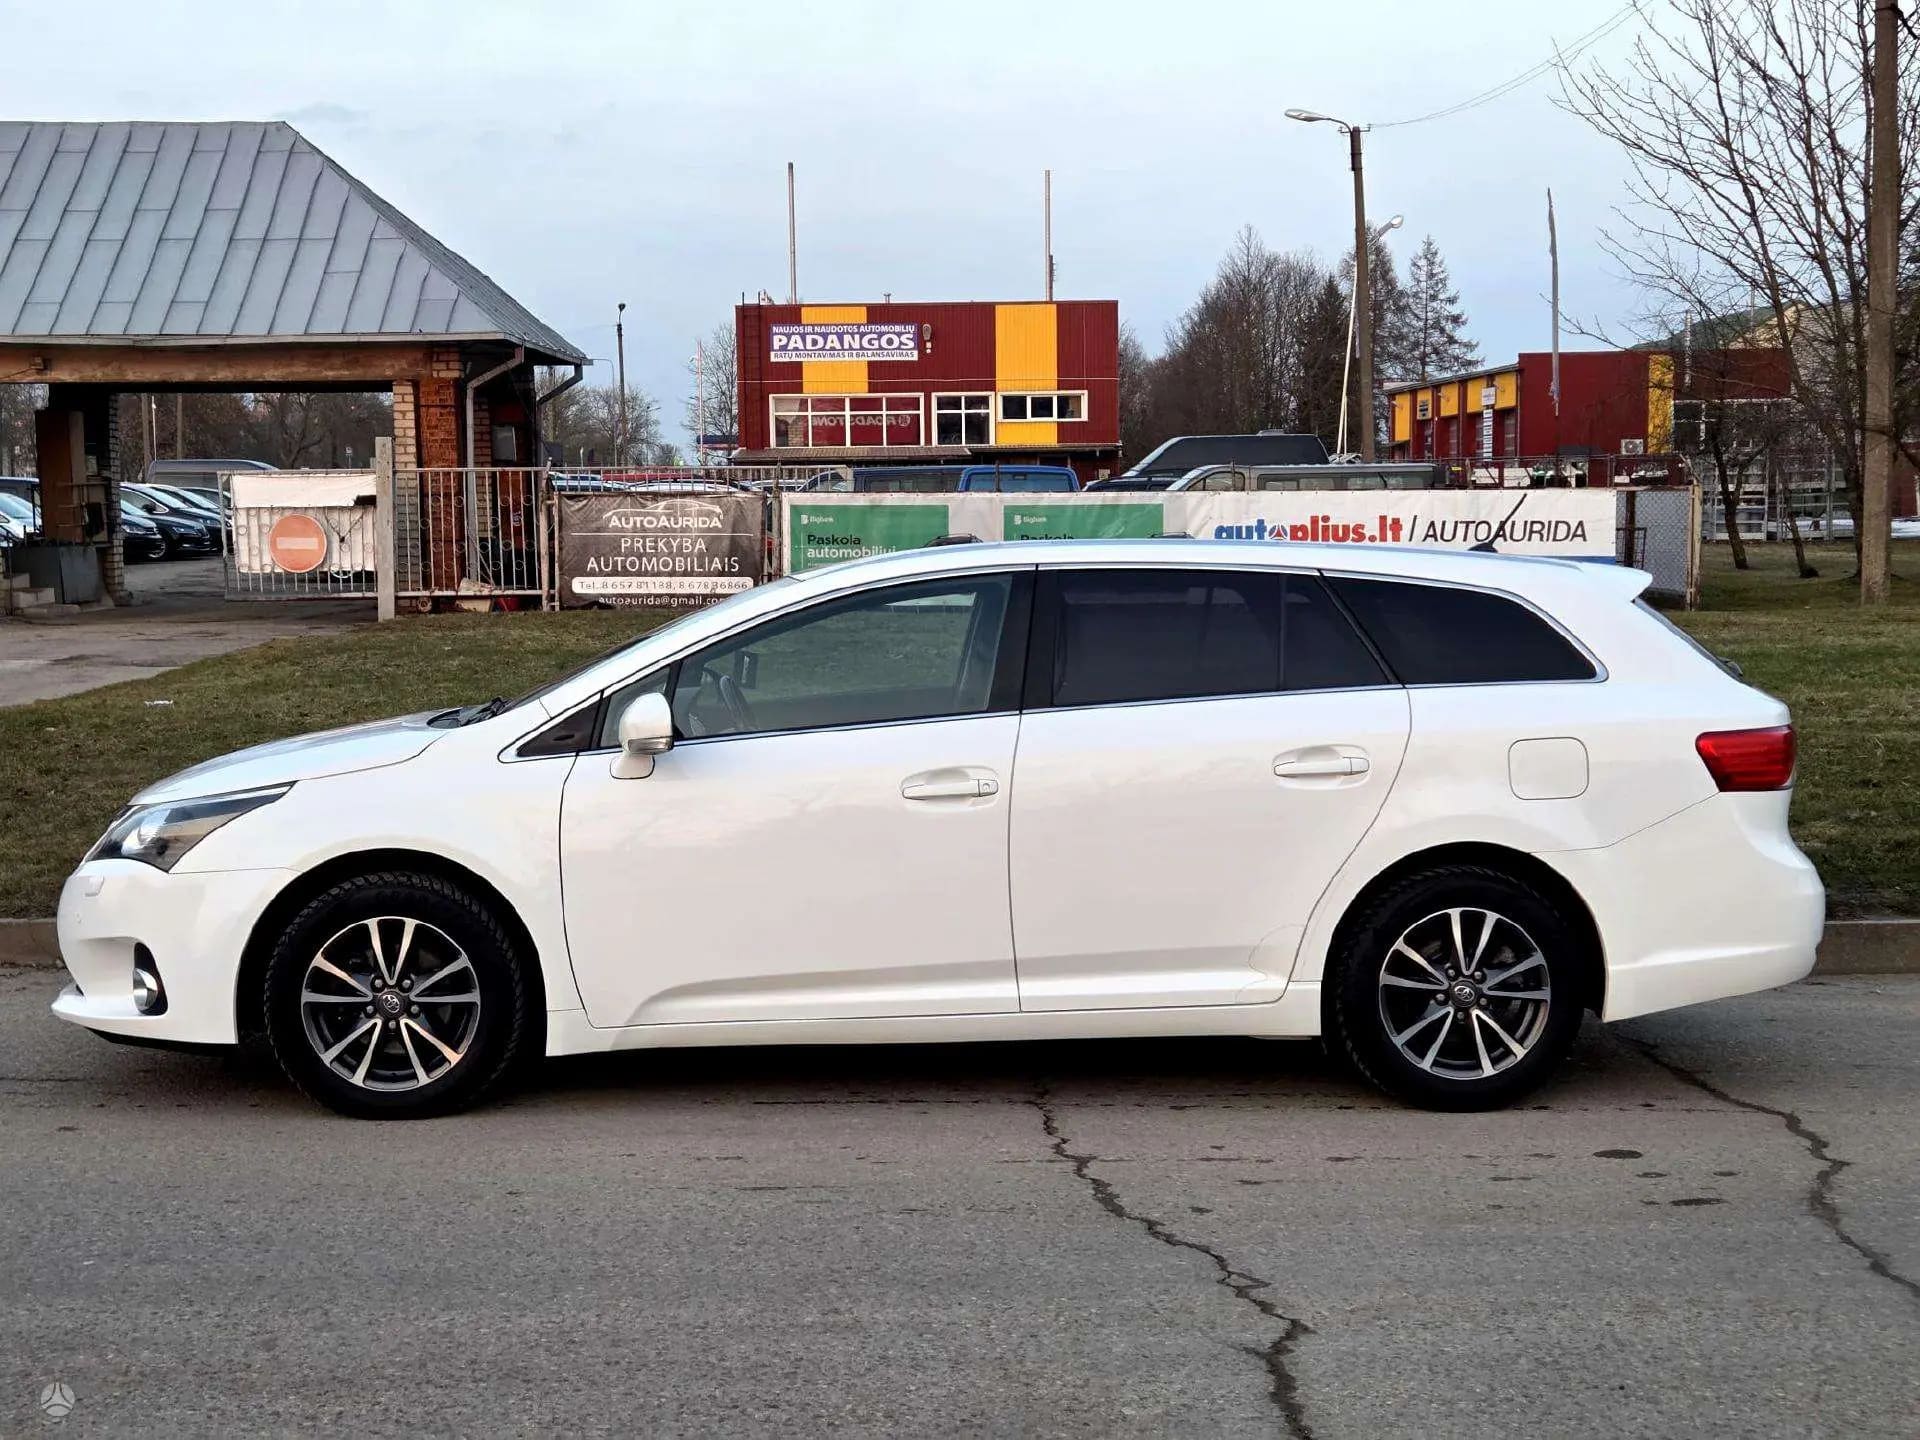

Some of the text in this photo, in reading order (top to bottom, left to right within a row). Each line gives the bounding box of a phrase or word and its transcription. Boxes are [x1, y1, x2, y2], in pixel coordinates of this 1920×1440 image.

[772, 325, 803, 333] NAUJOS
[805, 325, 813, 333] IR
[814, 325, 858, 333] NAUDOTOS
[773, 333, 915, 350] PADANGOS
[794, 351, 846, 359] MONTAVIMAS
[1422, 520, 1588, 542] AUTOAURIDA
[620, 537, 707, 553] PREKYBA
[806, 534, 862, 545] Paskola
[586, 556, 740, 573] AUTOMOBILIAIS
